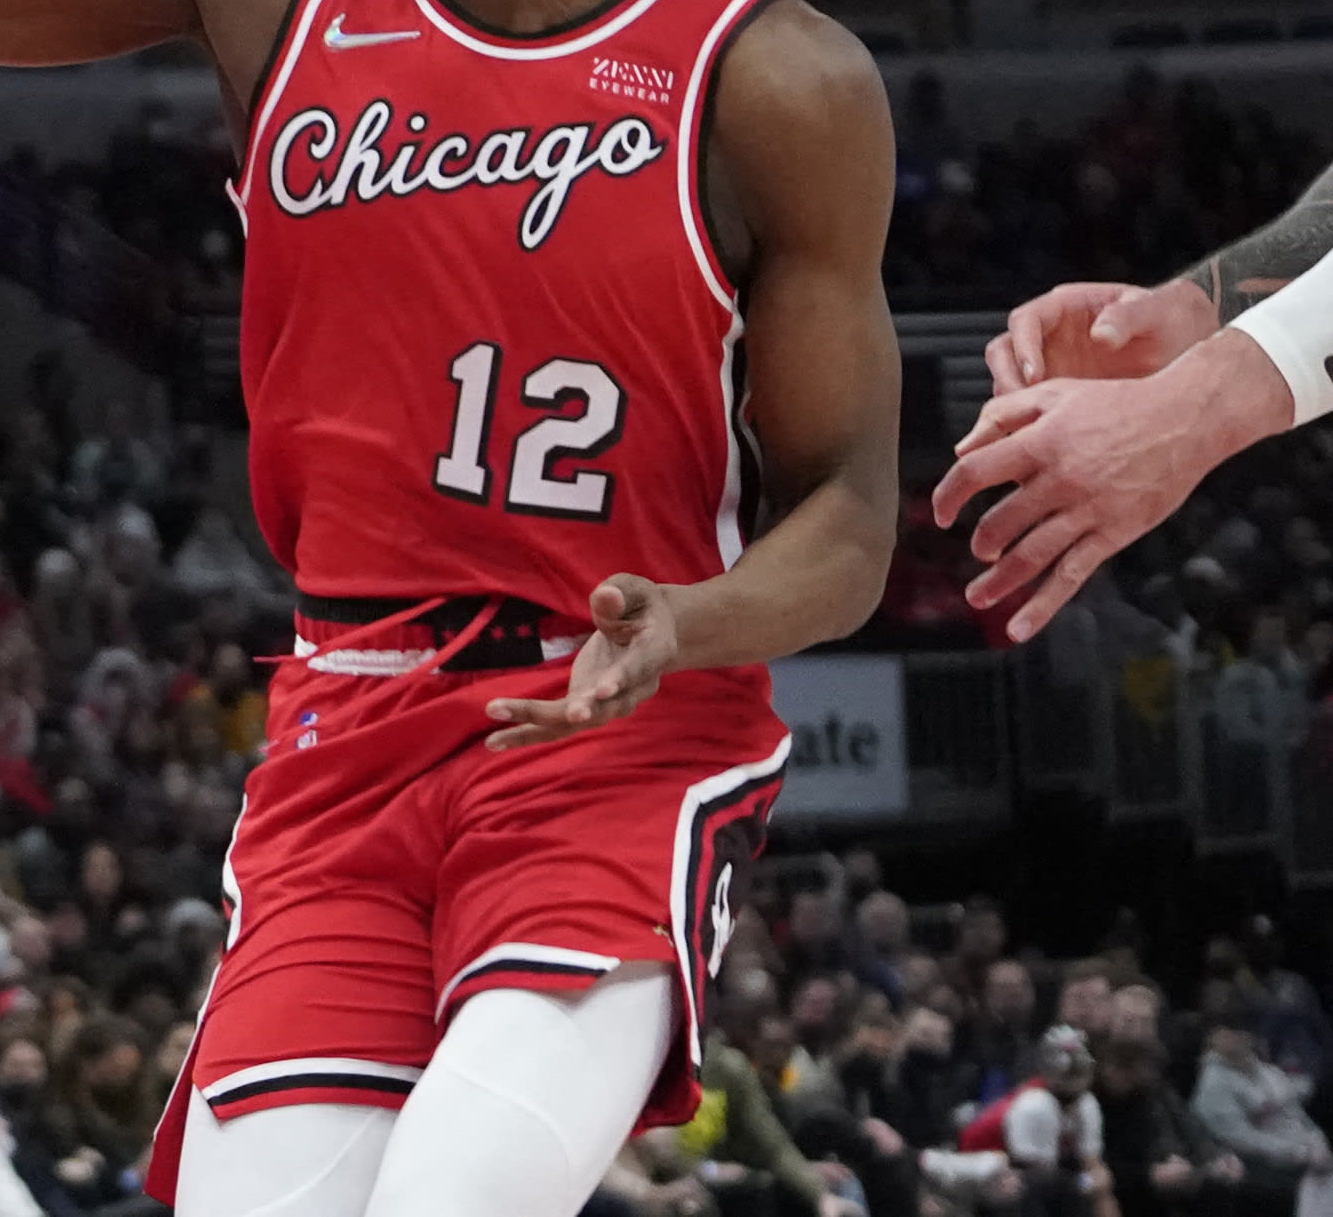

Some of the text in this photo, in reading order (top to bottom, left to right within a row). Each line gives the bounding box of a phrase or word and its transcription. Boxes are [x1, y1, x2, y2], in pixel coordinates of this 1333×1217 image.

[589, 77, 670, 105] EYEWEAR
[270, 98, 666, 253] Chicago
[432, 341, 627, 522] 12
